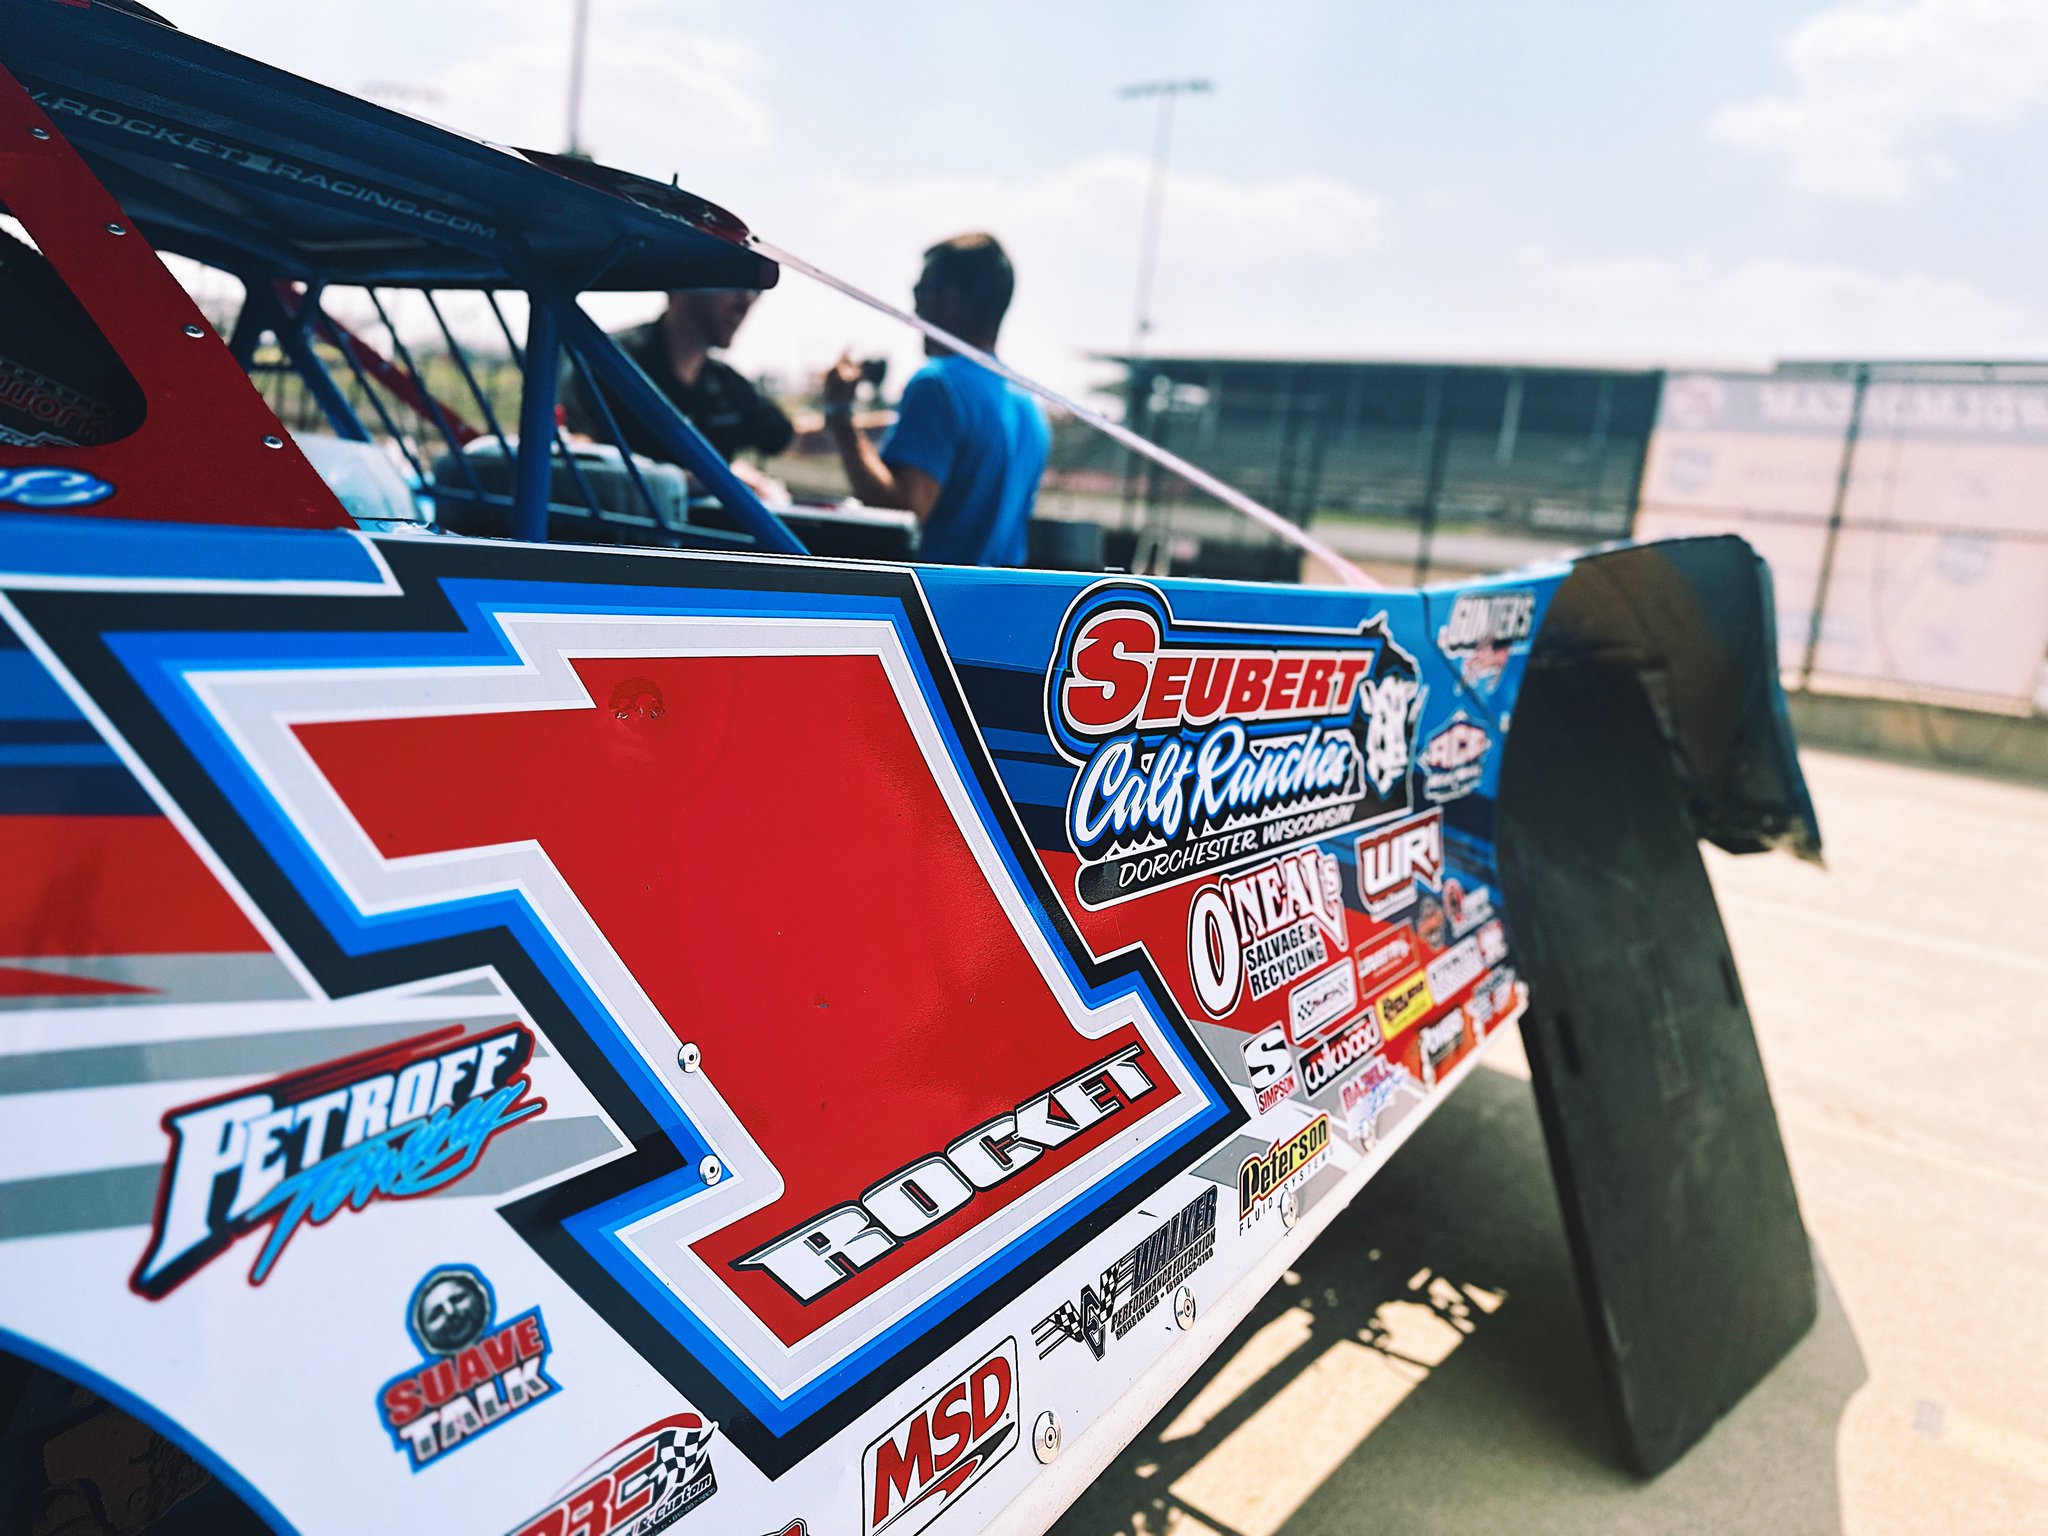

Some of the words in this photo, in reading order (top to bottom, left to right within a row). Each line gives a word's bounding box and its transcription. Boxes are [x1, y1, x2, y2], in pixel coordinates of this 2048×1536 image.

[1066, 616, 1368, 727] SEUBERT
[1075, 736, 1194, 842] Calf
[1189, 721, 1352, 824] Ranches
[1118, 831, 1259, 888] DORCHESTER,
[1262, 804, 1357, 846] WISCONSIN
[1245, 924, 1308, 971] SALVAGE
[1308, 923, 1318, 940] &
[1249, 941, 1325, 997] RECYCLING
[1258, 1076, 1295, 1112] SIMPSON
[140, 1033, 519, 1282] PETROFF
[730, 1042, 1156, 1305] ROCKET
[1241, 1117, 1328, 1213] Peterson
[1131, 1185, 1218, 1296] WALKER
[1238, 1196, 1274, 1237] FLUID
[1110, 1263, 1173, 1334] PERFORMANCE
[1172, 1227, 1217, 1279] FILTRATION
[1115, 1313, 1138, 1342] MADE
[1136, 1308, 1147, 1323] IN
[1145, 1294, 1161, 1314] USA
[384, 1315, 545, 1425] SUAVE
[400, 1356, 550, 1461] TALK
[872, 1356, 1013, 1529] MSD
